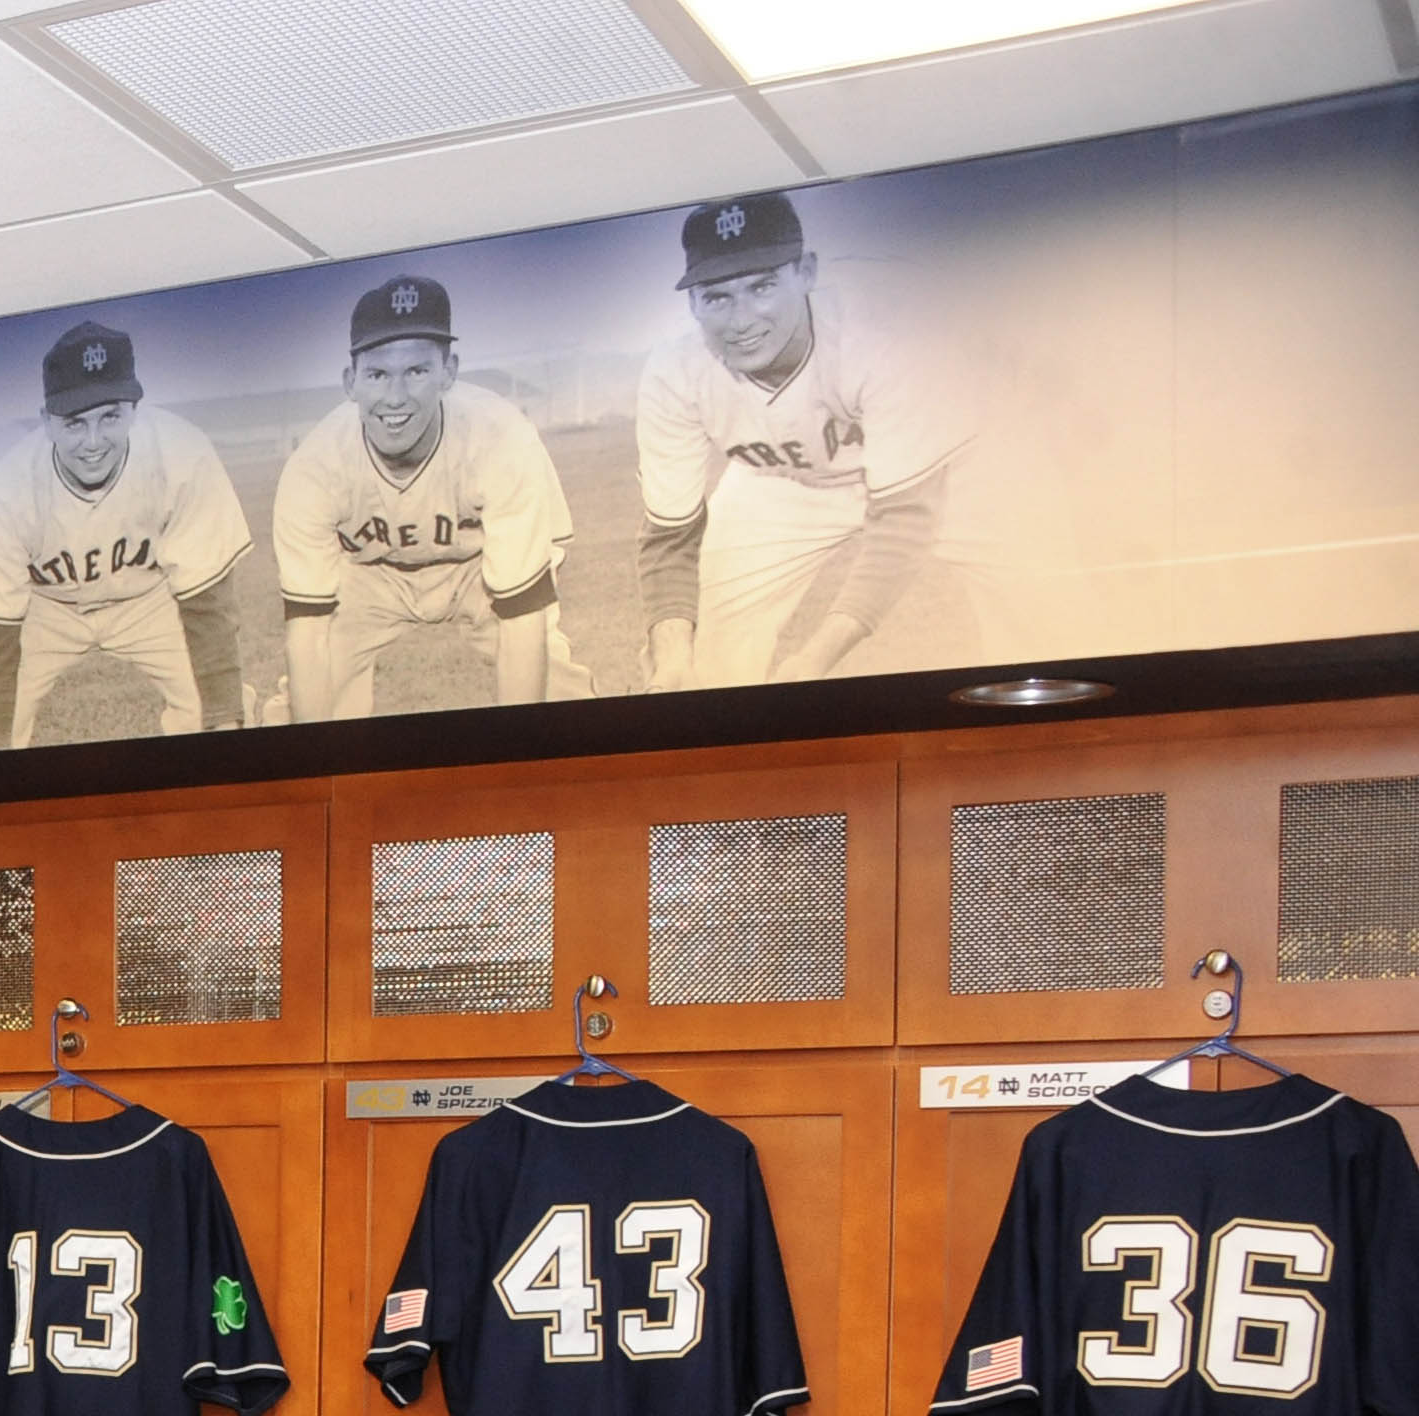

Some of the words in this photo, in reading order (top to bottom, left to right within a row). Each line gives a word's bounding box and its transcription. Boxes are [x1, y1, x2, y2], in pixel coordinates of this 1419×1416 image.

[937, 1074, 991, 1100] 14
[1029, 1072, 1088, 1083] MATT
[354, 1086, 407, 1111] 43
[436, 1097, 513, 1109] SPIZZIR
[439, 1085, 474, 1097] JOE
[1027, 1085, 1114, 1098] SCIOSC
[492, 1198, 712, 1366] 43
[6, 1228, 144, 1379] 13
[1075, 1214, 1336, 1401] 36
